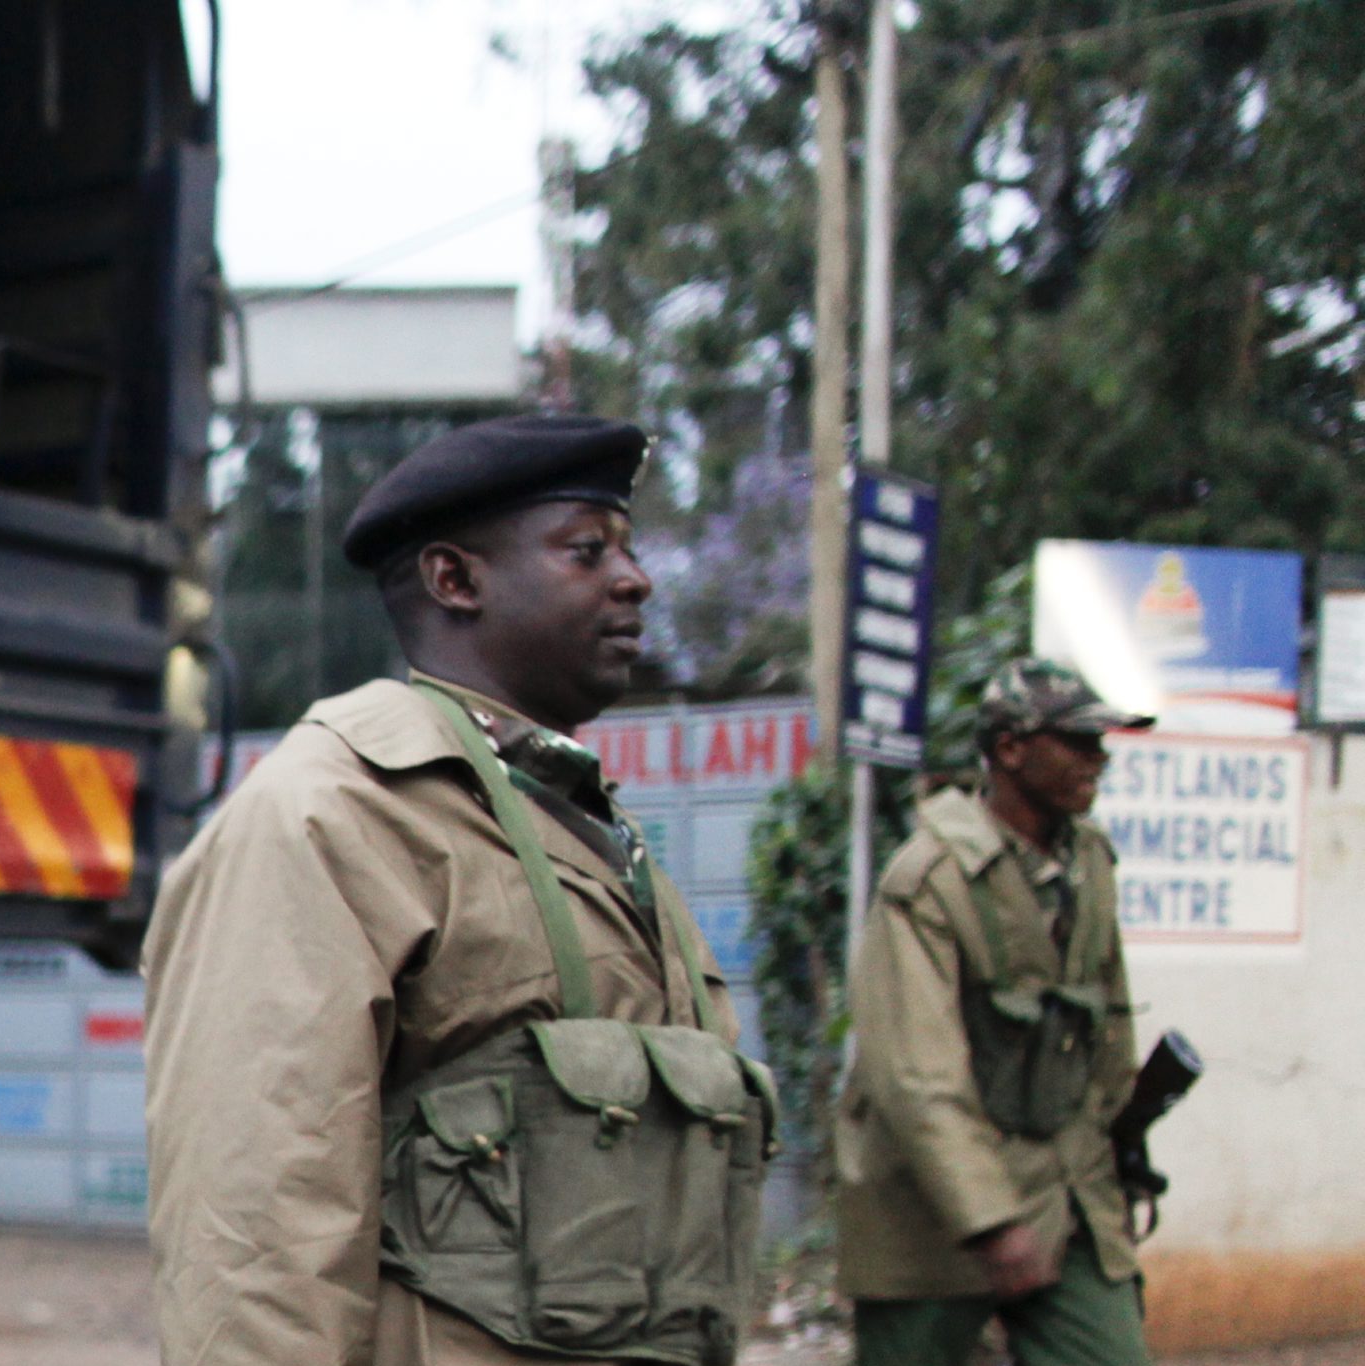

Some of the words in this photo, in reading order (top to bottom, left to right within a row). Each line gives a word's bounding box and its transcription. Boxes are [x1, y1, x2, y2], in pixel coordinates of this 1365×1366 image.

[576, 716, 778, 786] ULLAH
[1100, 750, 1287, 801] ESTLANDS
[1120, 877, 1231, 925] ENTRE
